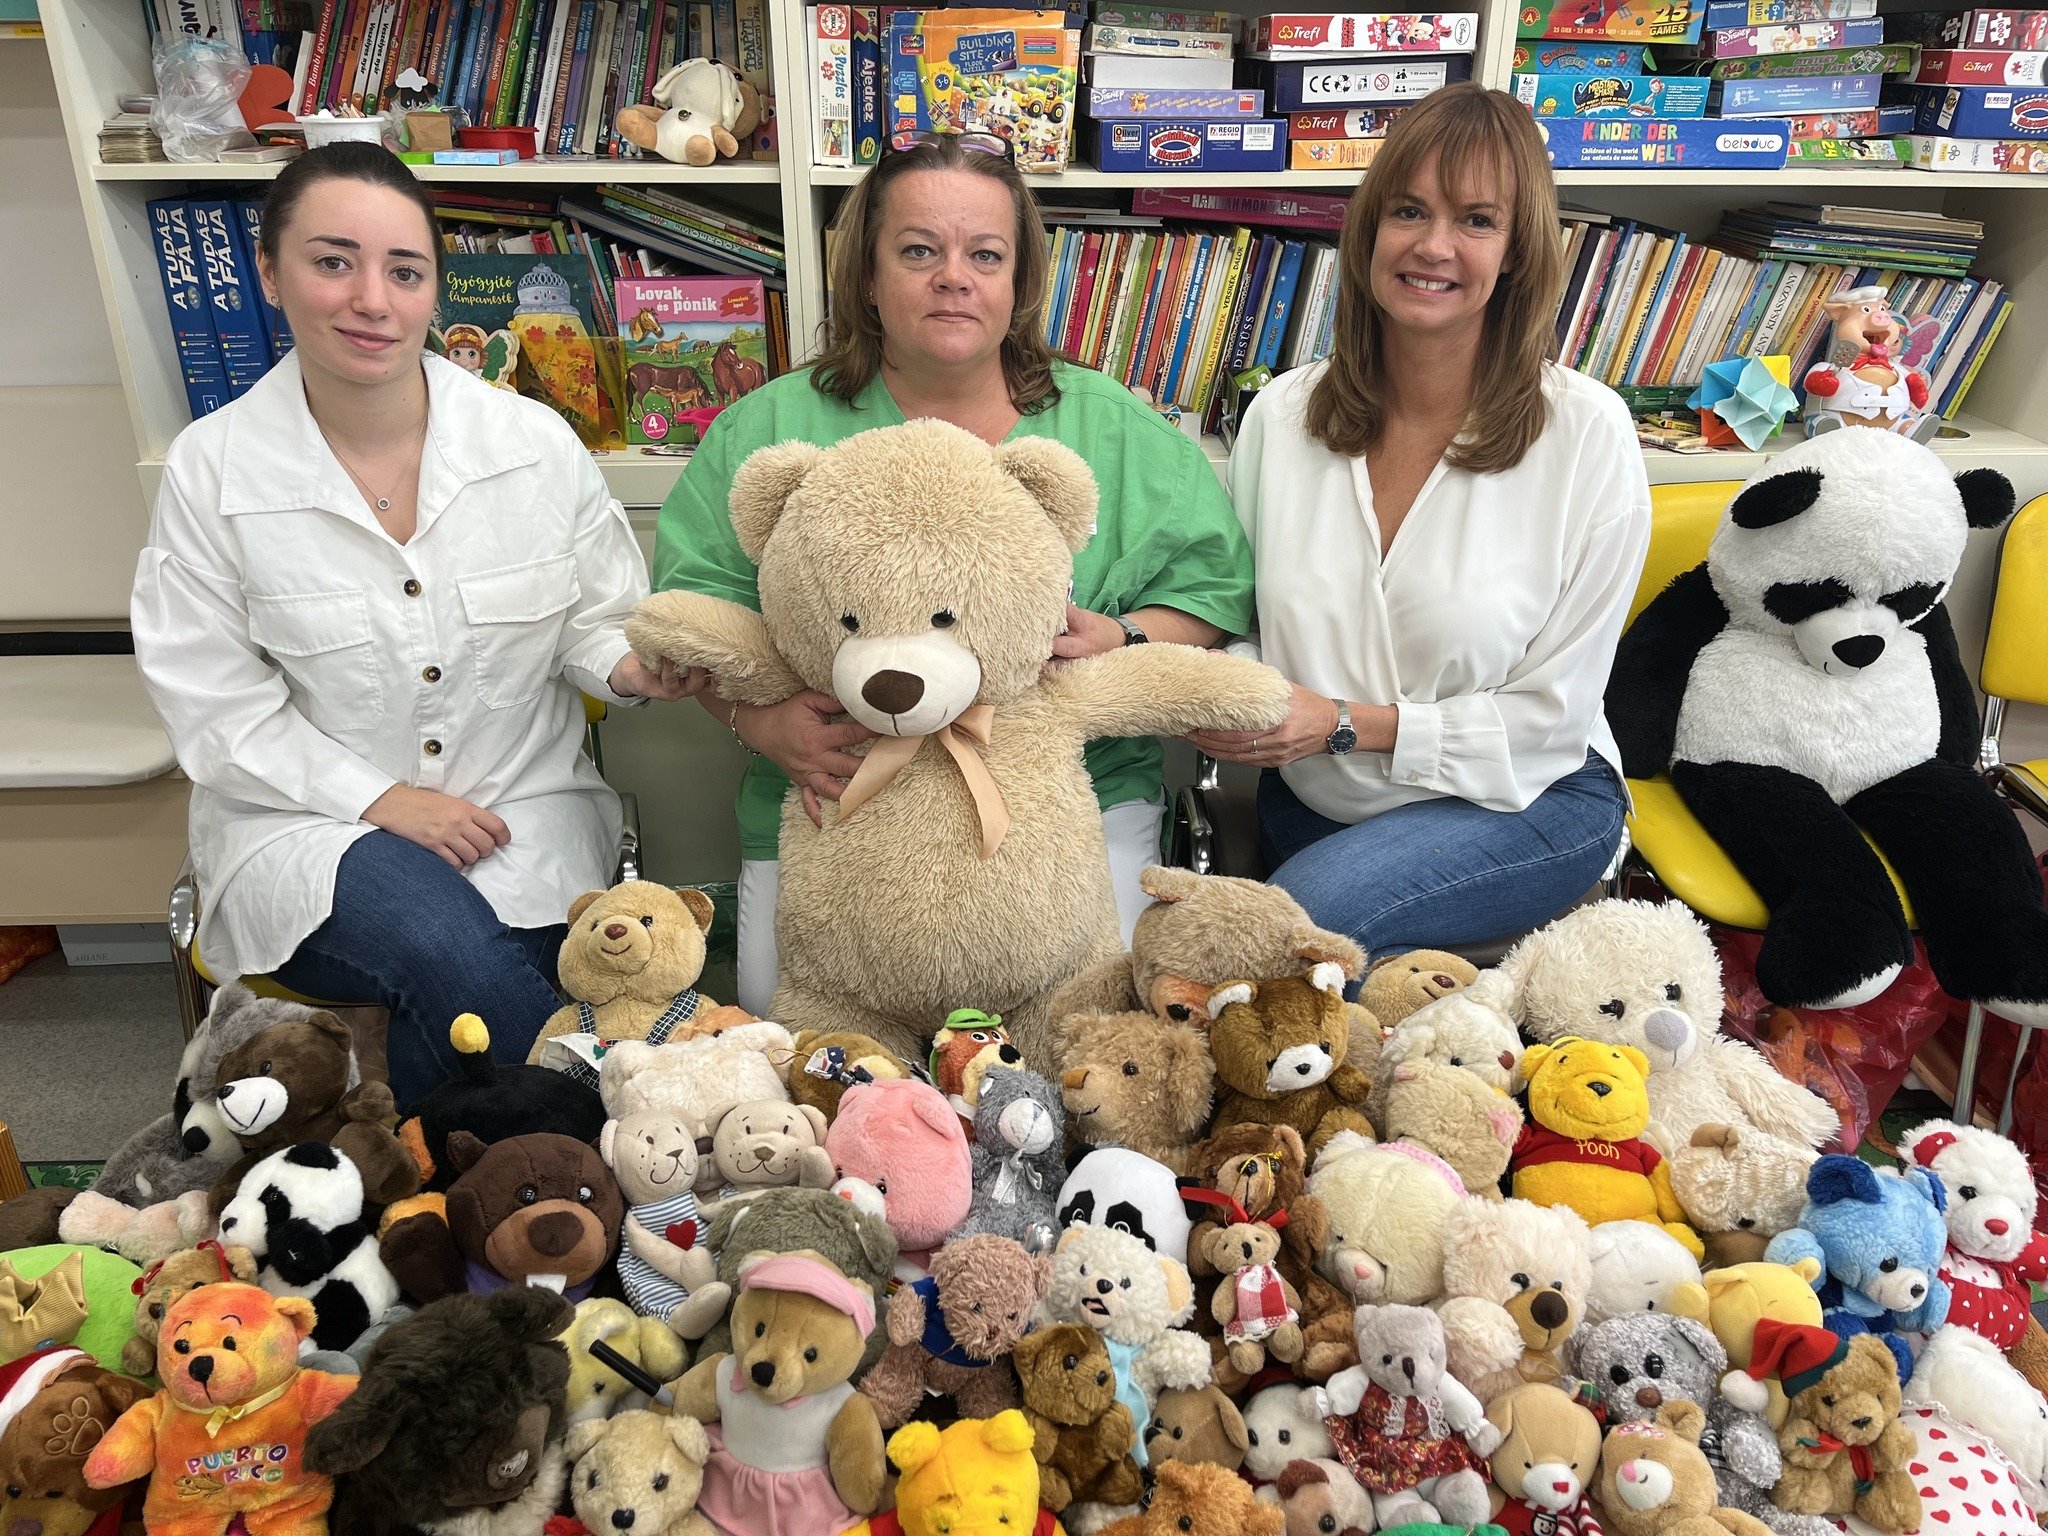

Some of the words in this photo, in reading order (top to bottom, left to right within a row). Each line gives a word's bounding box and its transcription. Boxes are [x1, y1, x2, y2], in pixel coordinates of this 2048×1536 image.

[1651, 2, 1690, 23] 25
[1709, 1, 1747, 11] Ravensburger
[1753, 1, 1764, 16] 100
[311, 1, 337, 54] gyermekei
[1294, 26, 1321, 40] Trefl
[1649, 24, 1686, 37] GAMES
[1845, 18, 1882, 29] Ravensburger
[362, 21, 377, 57] Veszélyes
[375, 22, 390, 57] Veszélyes
[959, 33, 1013, 51] BUILDING
[829, 43, 847, 55] 3
[959, 49, 985, 62] SITE
[306, 54, 323, 86] Bambi
[358, 57, 368, 74] nyár
[372, 58, 382, 75] nyár
[962, 65, 987, 74] PUZZLE
[964, 60, 983, 68] FLOOR
[1974, 61, 1993, 74] Trefl
[2027, 55, 2037, 80] PUZZLE
[627, 66, 638, 93] Földrajzi
[834, 56, 847, 98] Puzzles
[936, 76, 949, 88] 3-6
[860, 58, 875, 122] Ajedrez
[1879, 107, 1914, 117] Ravensburger
[1115, 125, 1140, 137] Oliver
[1311, 115, 1337, 130] Trefl
[1582, 121, 1643, 142] KINDER
[1647, 122, 1679, 141] DER
[1641, 143, 1686, 164] WELT
[1821, 140, 1836, 157] 24
[1997, 148, 2005, 160] 260
[156, 207, 182, 290] TUDÁS
[170, 207, 200, 285] FÁJA
[195, 208, 224, 291] TUDÁS
[208, 208, 240, 286] FÁJA
[1191, 246, 1210, 284] magyarázat
[446, 271, 516, 293] Gyógyító
[1188, 283, 1199, 300] nincs
[173, 292, 188, 311] A
[214, 293, 230, 312] A
[447, 290, 515, 306] lámpamesék
[634, 286, 683, 301] Lovak
[1764, 270, 1799, 331] KISASSZONY
[656, 302, 669, 312] és
[672, 296, 718, 315] pónik
[1183, 300, 1195, 319] Amire
[1203, 349, 1218, 380] TALÁLÓS
[1230, 245, 1244, 270] DALOK
[1619, 310, 1650, 371] állattörténetek
[1642, 268, 1664, 310] kicsiknek
[207, 400, 216, 411] 1
[648, 415, 658, 429] 4
[1574, 1139, 1620, 1160] Pooh
[185, 1443, 289, 1476] PUERTO
[223, 1463, 285, 1485] RICO
